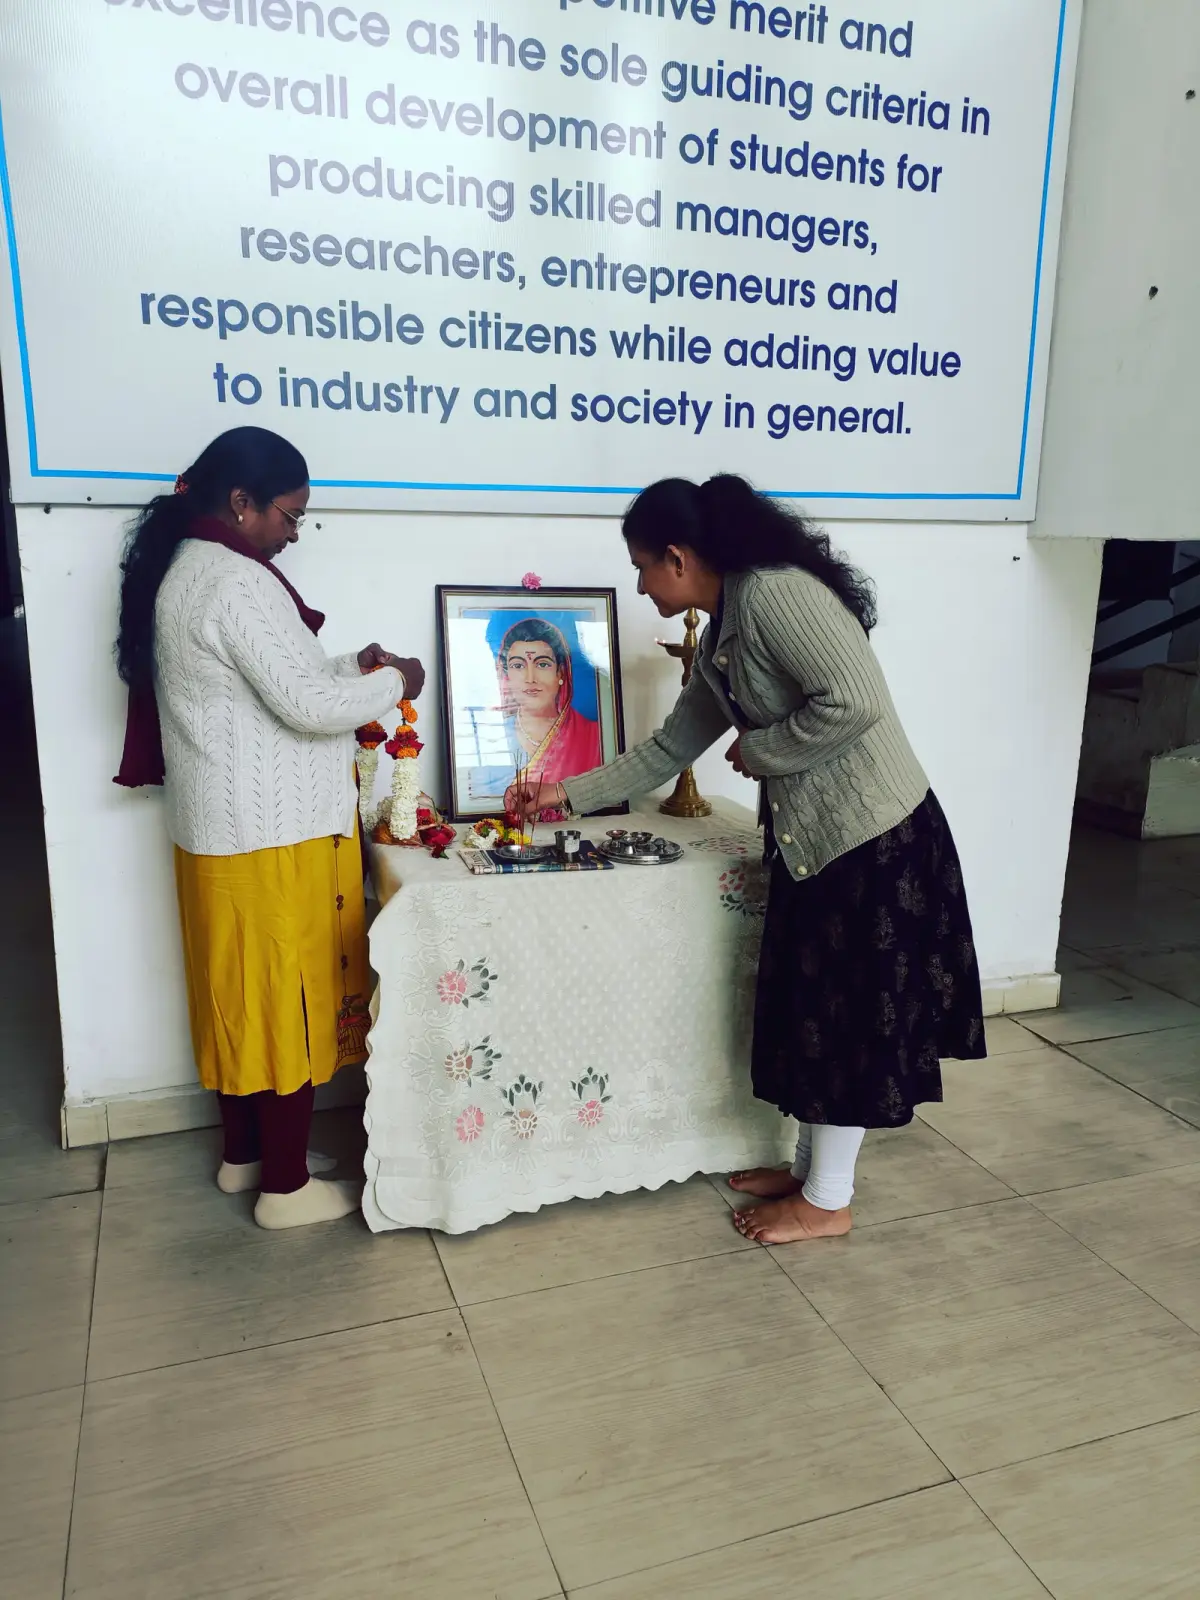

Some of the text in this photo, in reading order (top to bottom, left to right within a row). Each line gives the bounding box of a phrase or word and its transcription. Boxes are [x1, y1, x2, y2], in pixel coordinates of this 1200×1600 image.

[104, 0, 991, 136] ellence as the sole guiding criteria in
[730, 0, 828, 44] merit
[840, 19, 913, 58] and
[175, 63, 943, 193] overall development of students for
[269, 154, 877, 256] producing skilled managers,
[240, 226, 897, 314] researchers, entrepreneurs and
[140, 293, 961, 382] responsible citizens while adding value
[213, 363, 911, 440] to industry and society in general.
